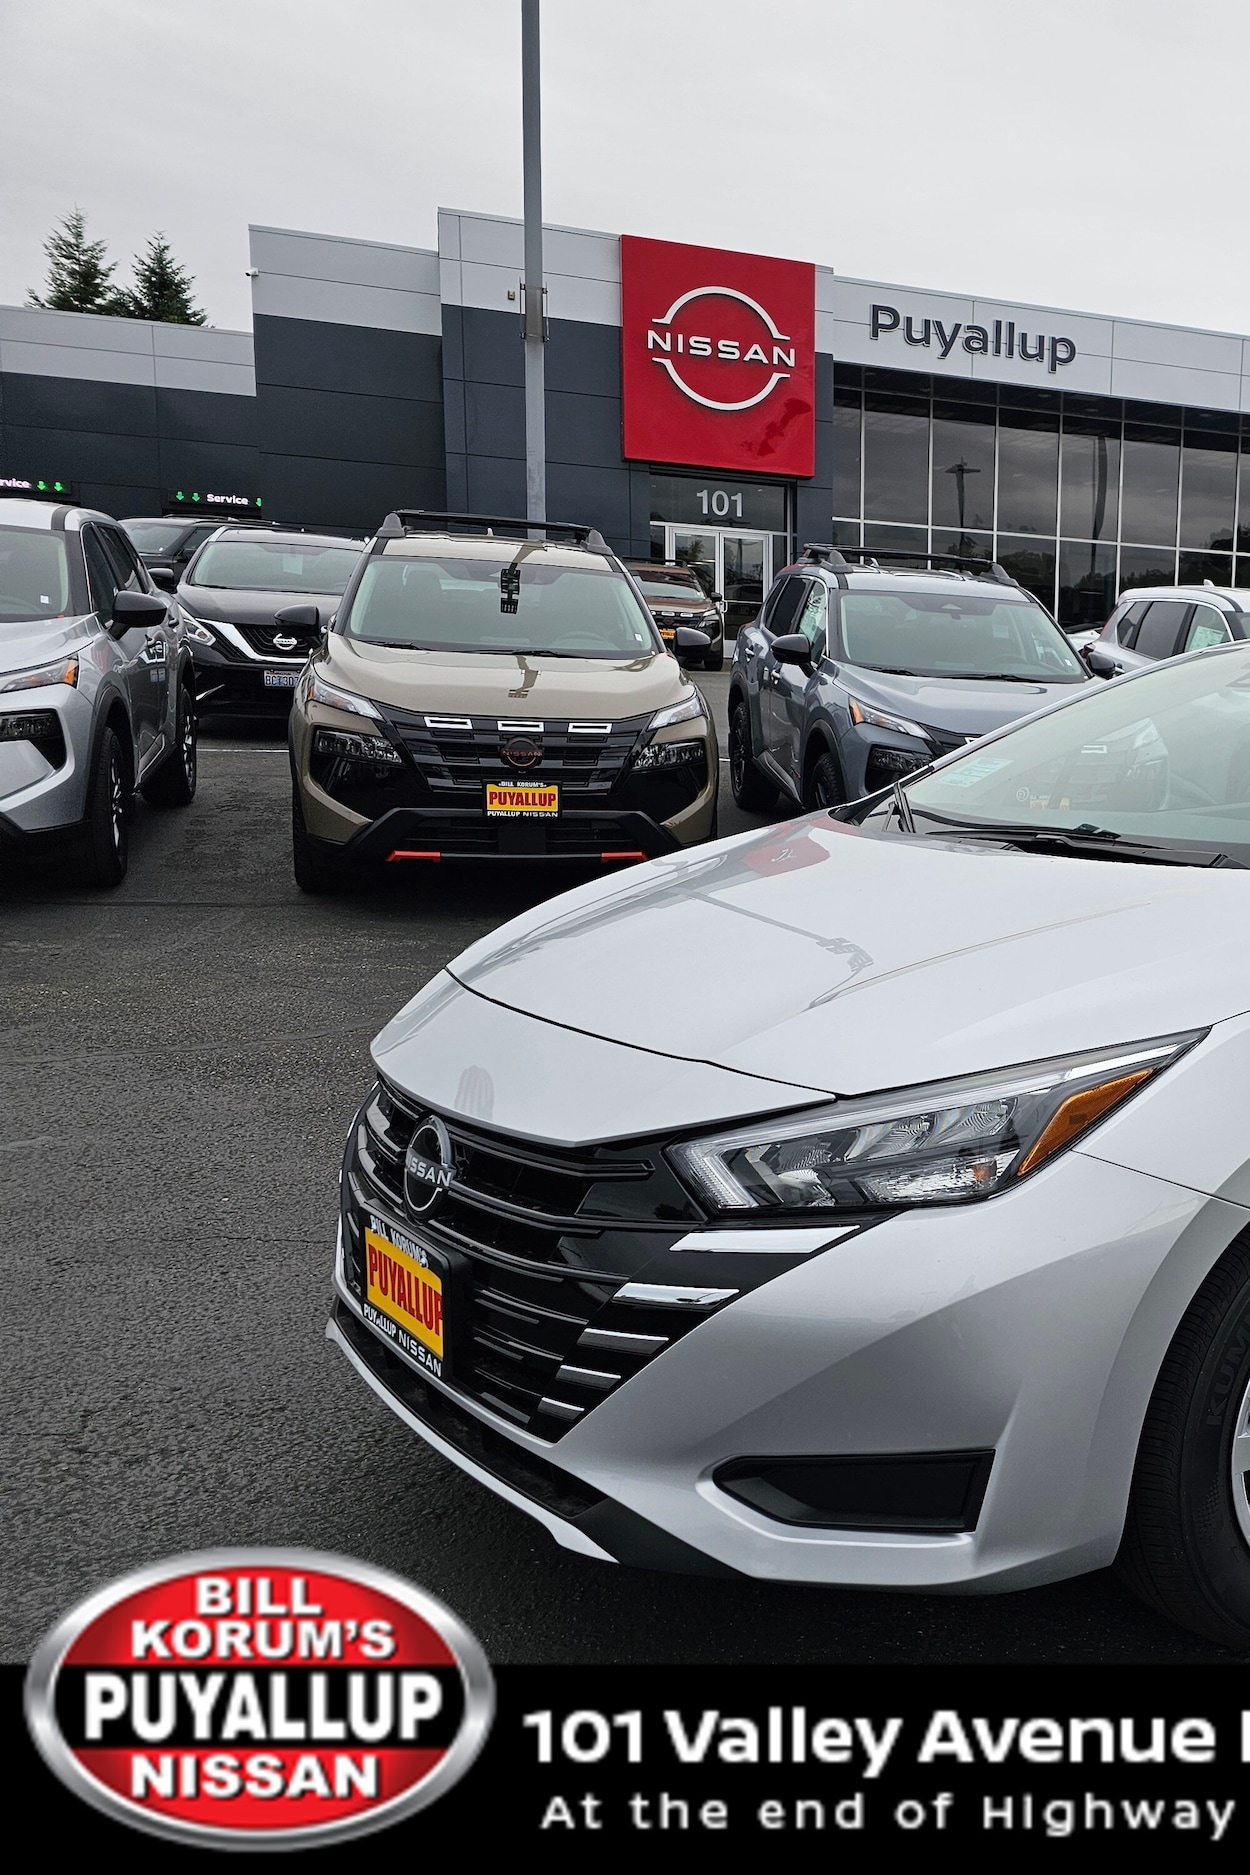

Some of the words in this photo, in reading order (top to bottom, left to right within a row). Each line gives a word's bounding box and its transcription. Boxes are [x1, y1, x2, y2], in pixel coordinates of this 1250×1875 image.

[647, 329, 796, 367] NISSAN
[870, 303, 1077, 374] Puyallup
[0, 478, 32, 489] rvice
[206, 493, 249, 505] Service
[696, 489, 744, 518] 101
[489, 791, 557, 807] PUYALLUP
[368, 1244, 443, 1336] PUYALLUP
[363, 1302, 397, 1339] PUYALLUP
[398, 1328, 442, 1378] NISSAN
